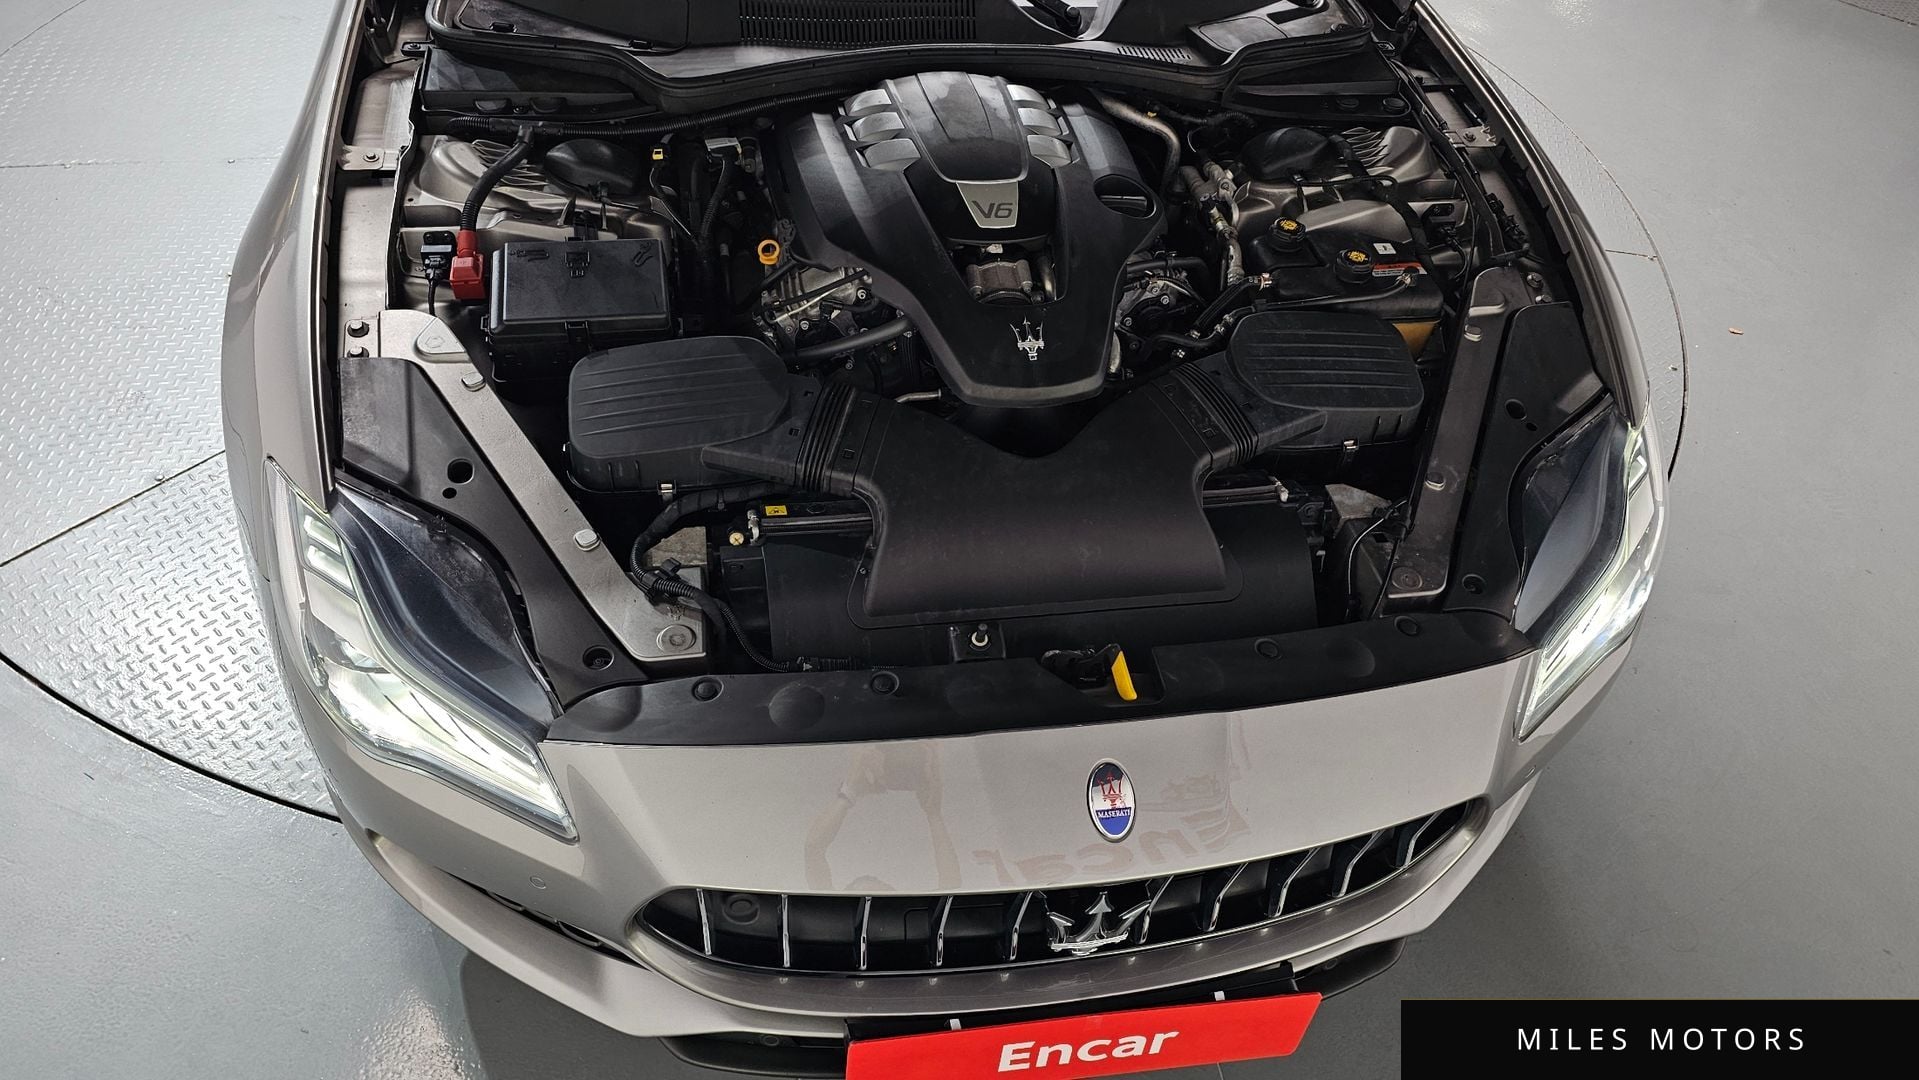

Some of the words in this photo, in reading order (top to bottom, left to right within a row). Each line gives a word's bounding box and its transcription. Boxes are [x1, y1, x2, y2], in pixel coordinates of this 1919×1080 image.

[972, 201, 1013, 218] V6
[1097, 809, 1131, 818] MASERATI
[998, 1031, 1180, 1072] Encar
